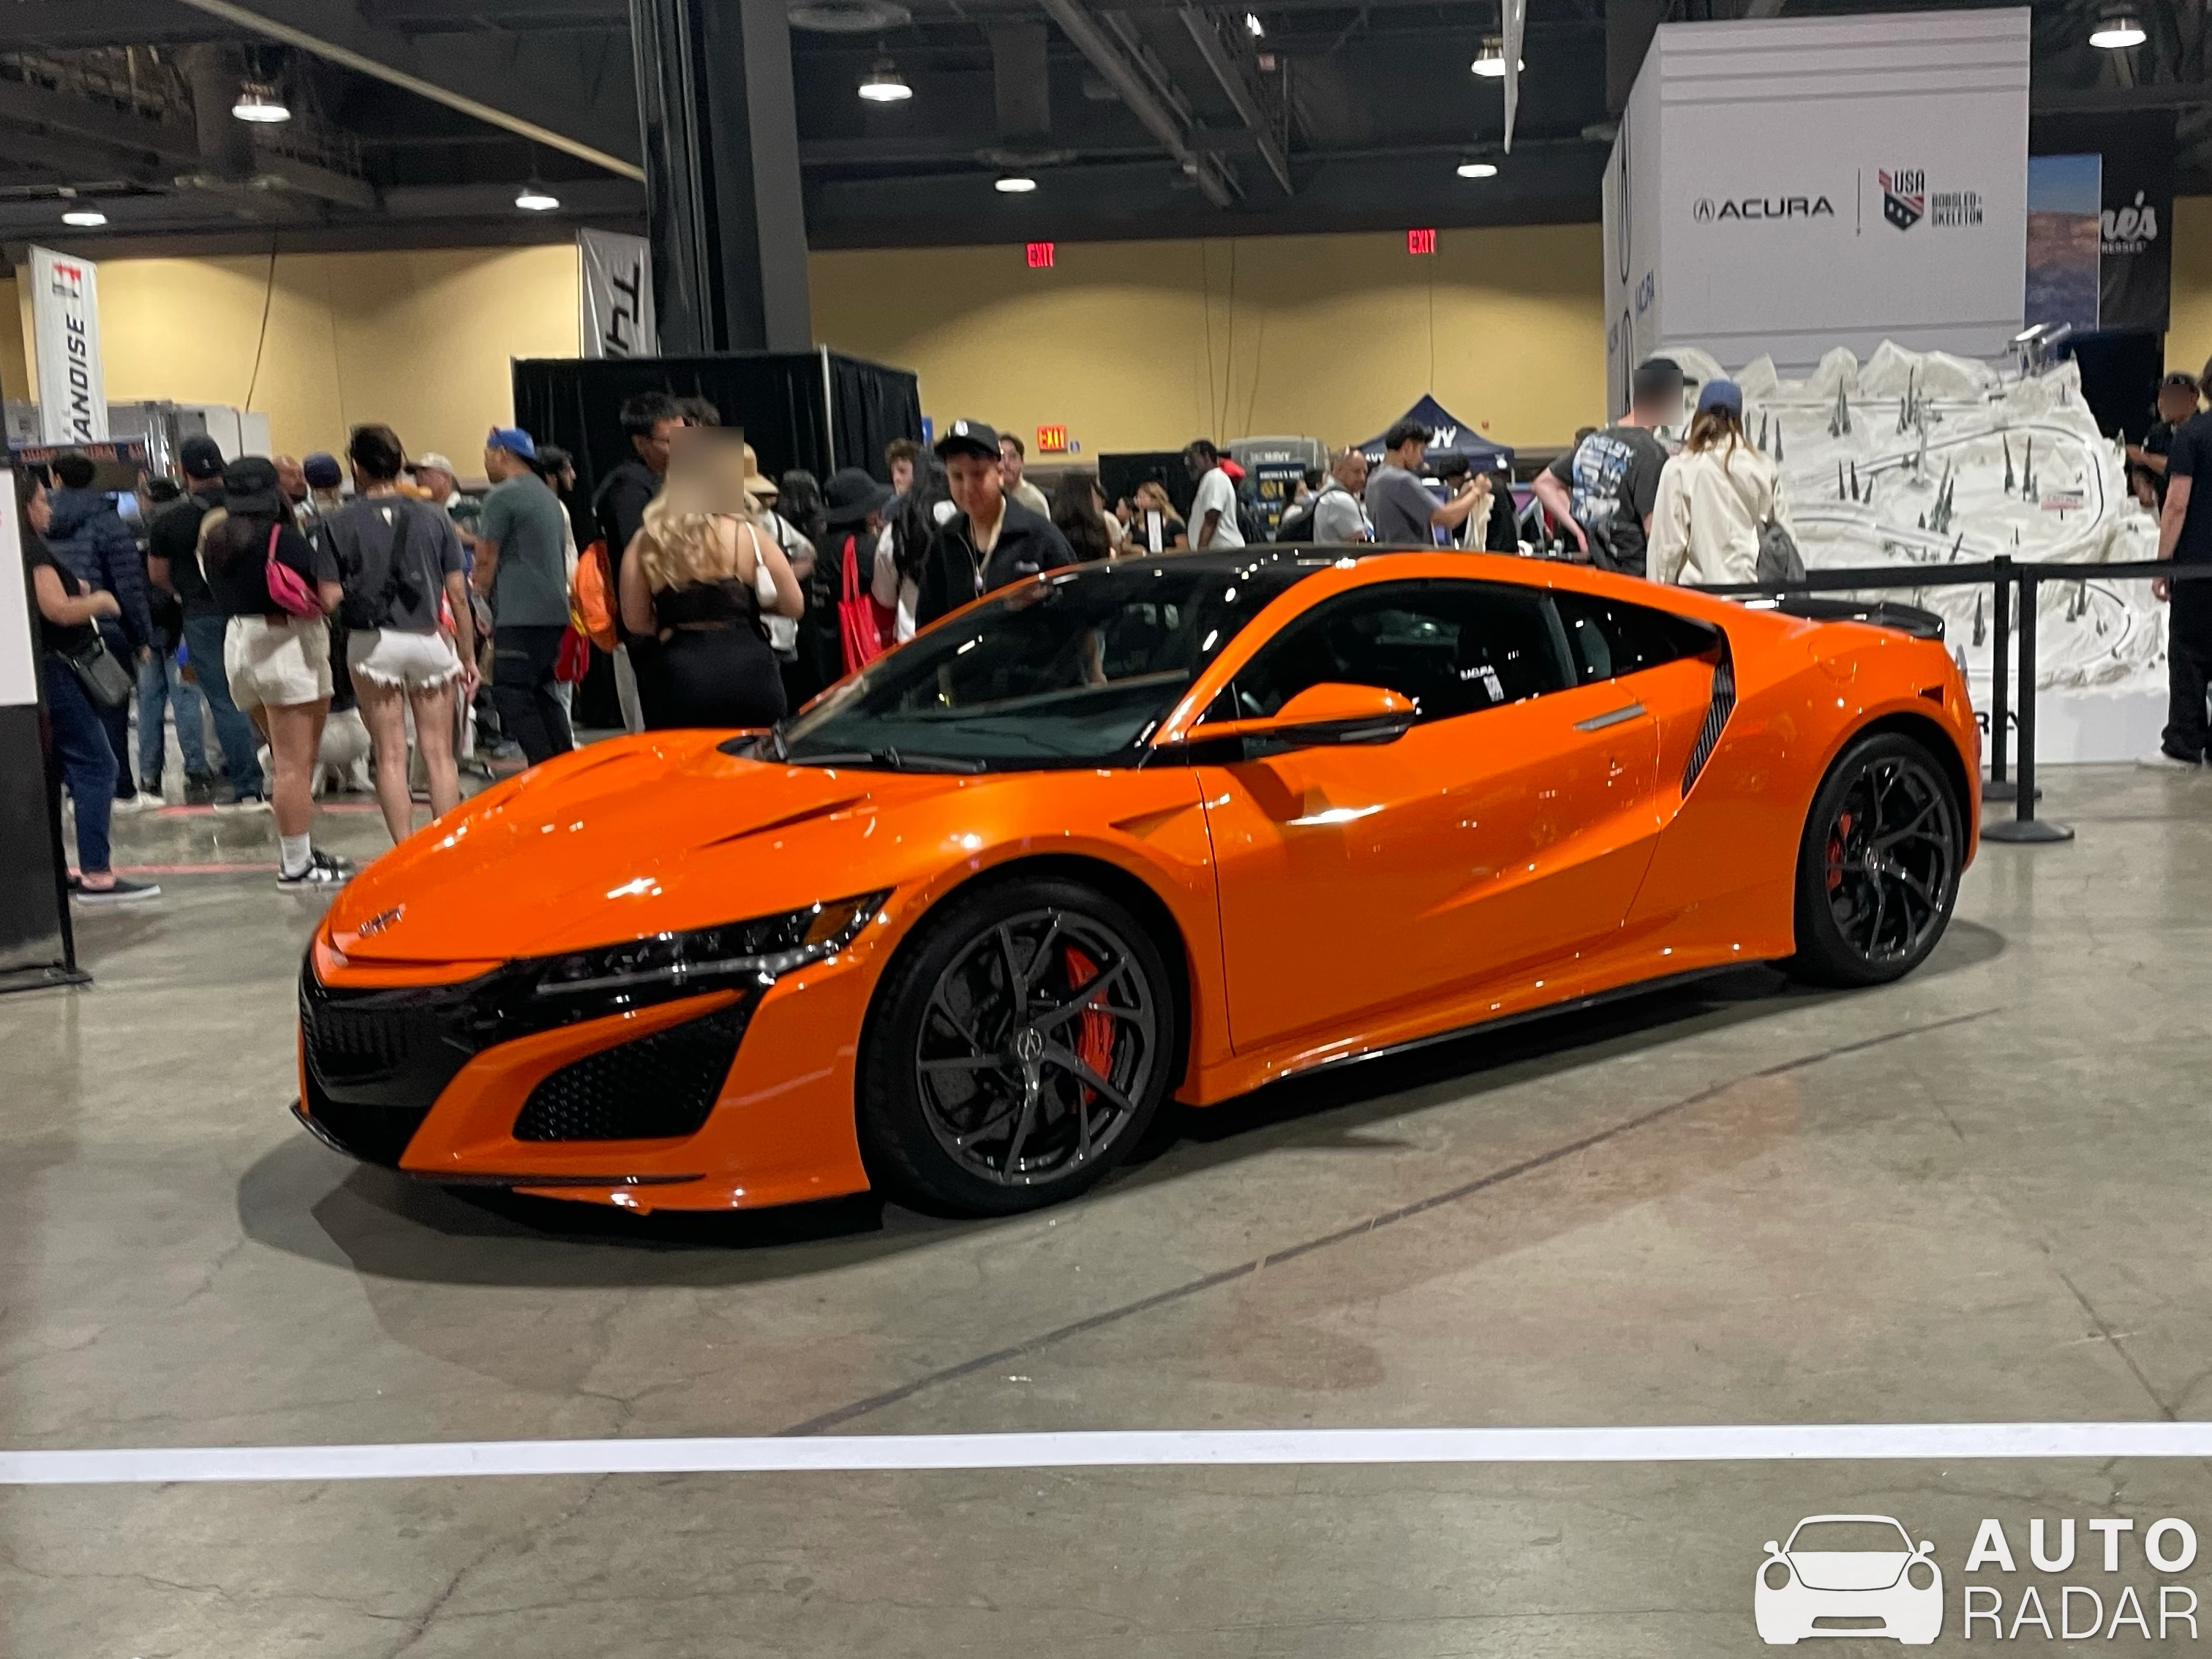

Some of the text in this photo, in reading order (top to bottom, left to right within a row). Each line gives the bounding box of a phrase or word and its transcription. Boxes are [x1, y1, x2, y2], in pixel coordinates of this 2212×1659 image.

[1895, 169, 1925, 193] USA
[1718, 195, 1835, 220] ACURA
[1409, 229, 1435, 254] EXIT
[1027, 244, 1053, 267] EXIT
[1039, 426, 1065, 449] EXIT
